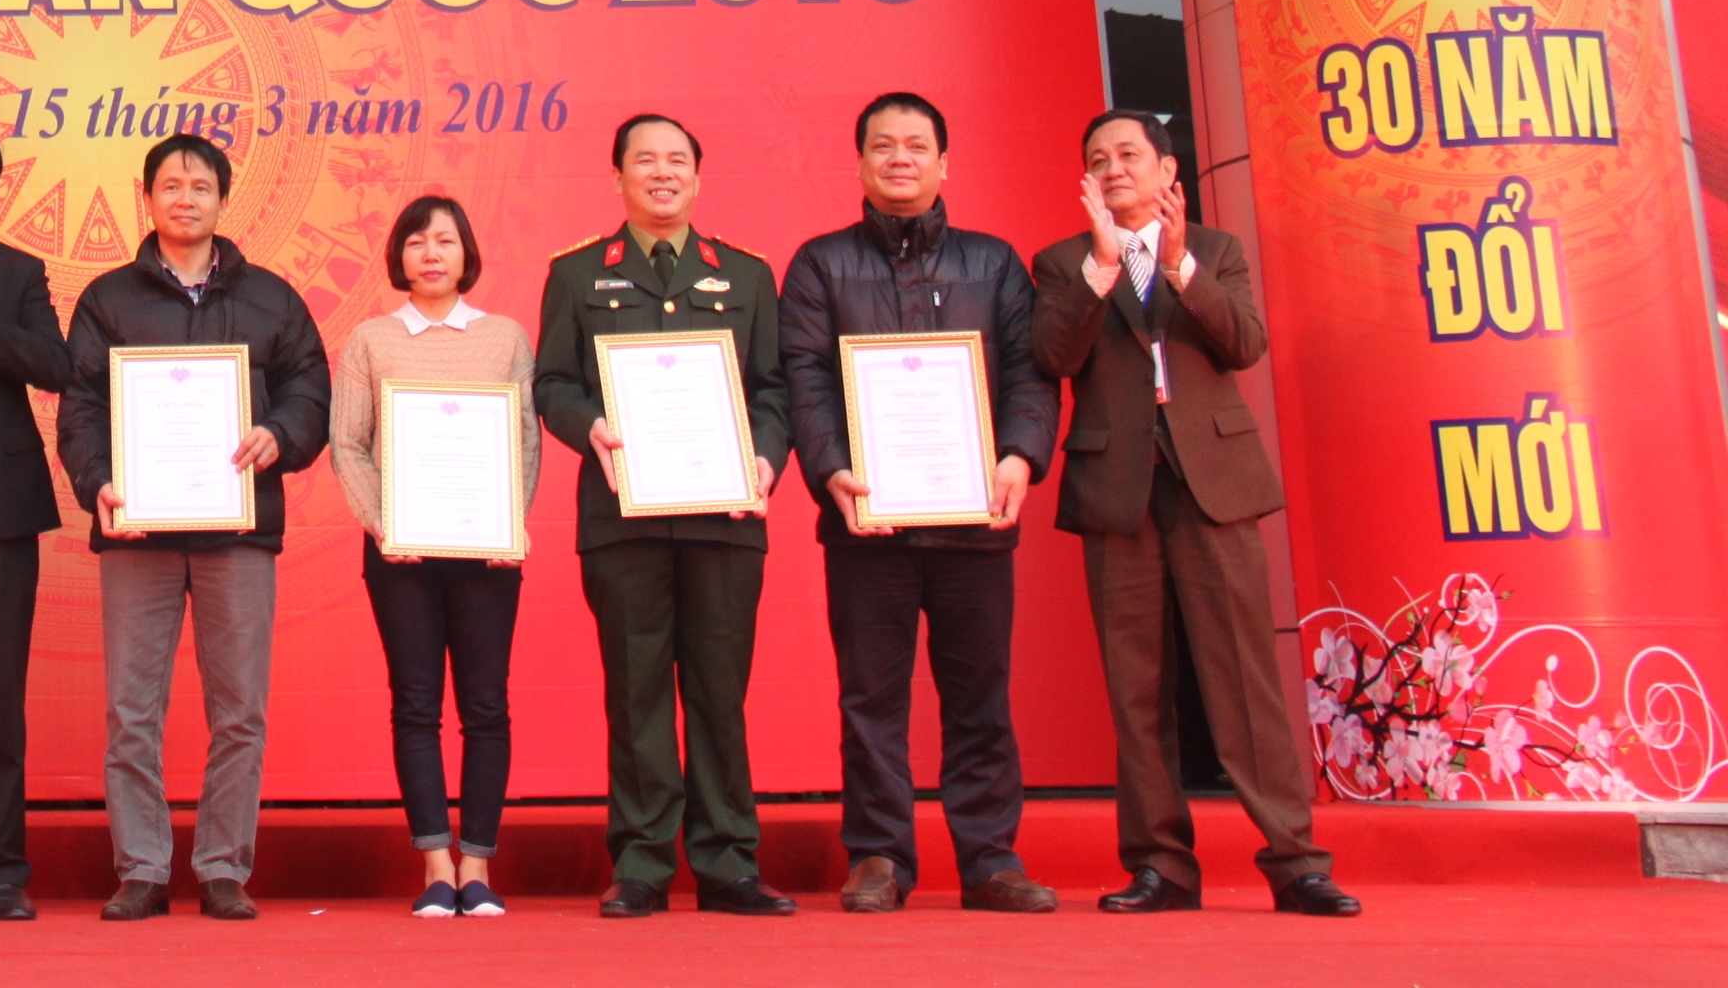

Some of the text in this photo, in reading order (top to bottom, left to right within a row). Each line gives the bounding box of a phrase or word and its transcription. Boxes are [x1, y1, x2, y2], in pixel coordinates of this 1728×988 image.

[9, 86, 69, 139] 15
[85, 85, 241, 151] tháng
[257, 85, 286, 137] 3
[306, 83, 421, 135] năm
[441, 80, 569, 134] 2016
[1316, 5, 1620, 159] 30 NĂM
[1417, 175, 1570, 343] ĐỔI
[1430, 391, 1612, 543] MỚI
